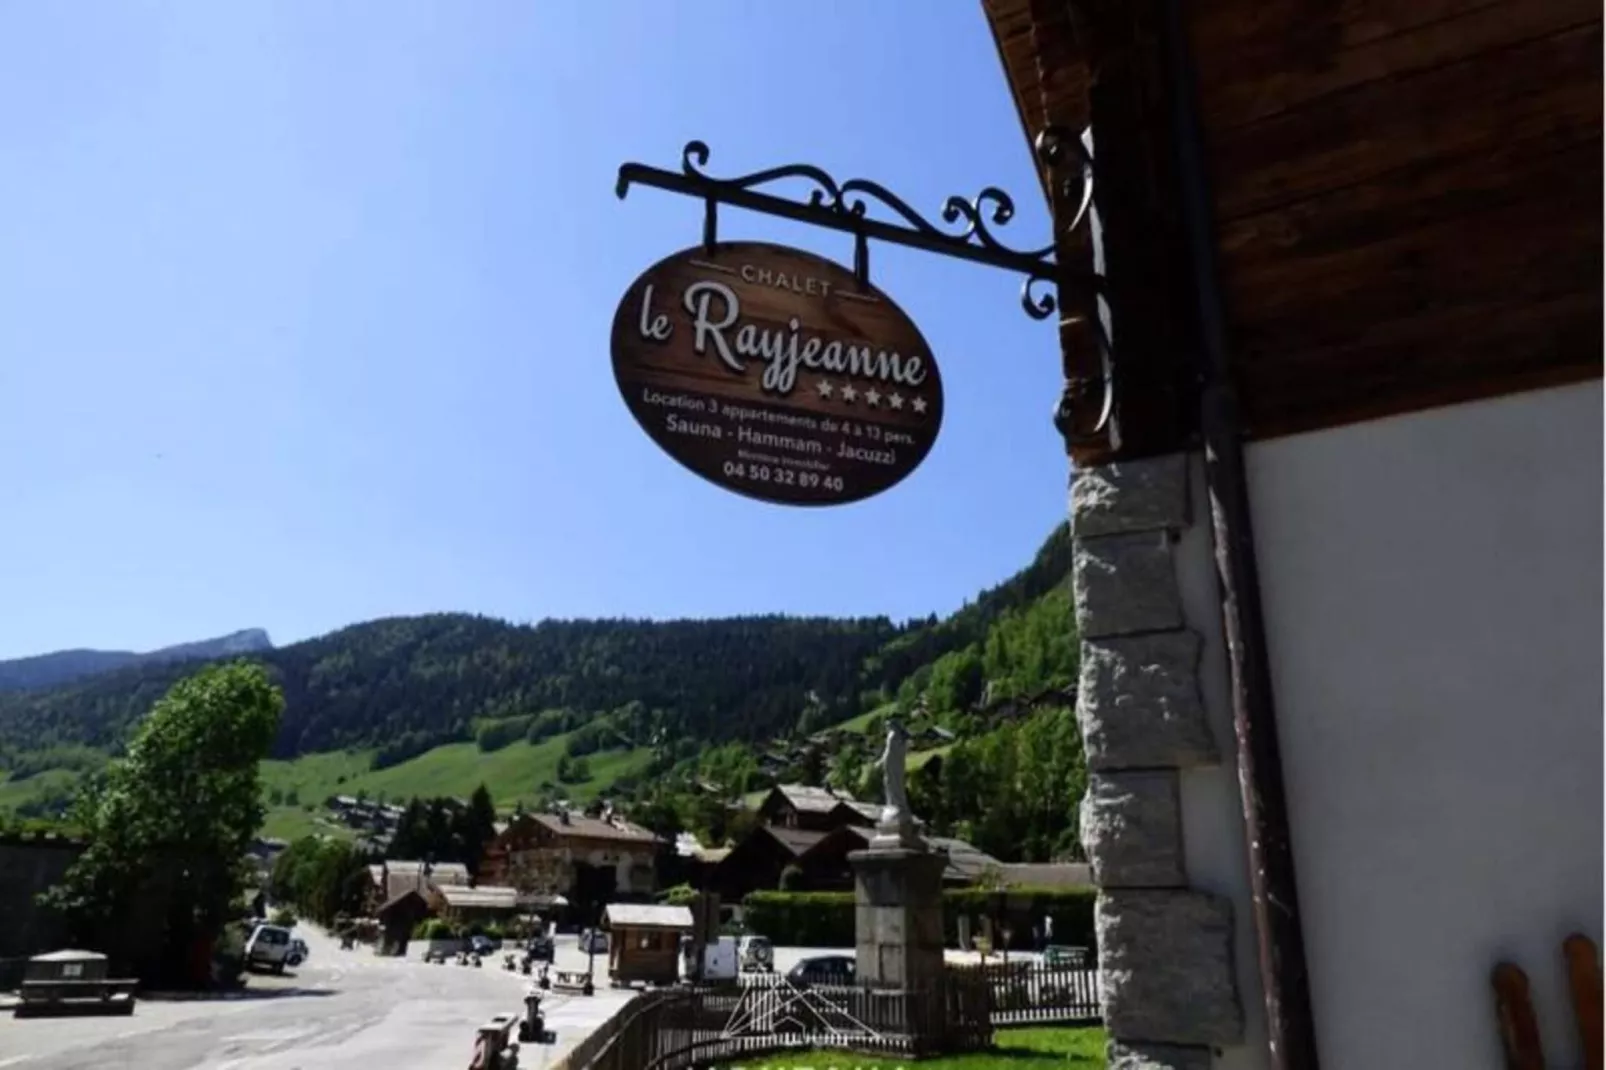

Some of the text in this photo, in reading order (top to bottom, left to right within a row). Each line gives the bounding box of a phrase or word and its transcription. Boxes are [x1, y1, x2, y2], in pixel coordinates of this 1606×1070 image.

[741, 264, 832, 297] CHALET
[640, 281, 928, 392] le Rayjeanne
[643, 388, 706, 411] Location
[708, 398, 718, 413] 3
[722, 404, 817, 429] appartements
[820, 418, 839, 433] de
[841, 421, 851, 435] 4
[665, 413, 722, 438] Sauna
[738, 425, 821, 453] Hammam
[836, 441, 896, 465] Jacuzzi
[723, 461, 844, 492] 04 50 32 89 40
